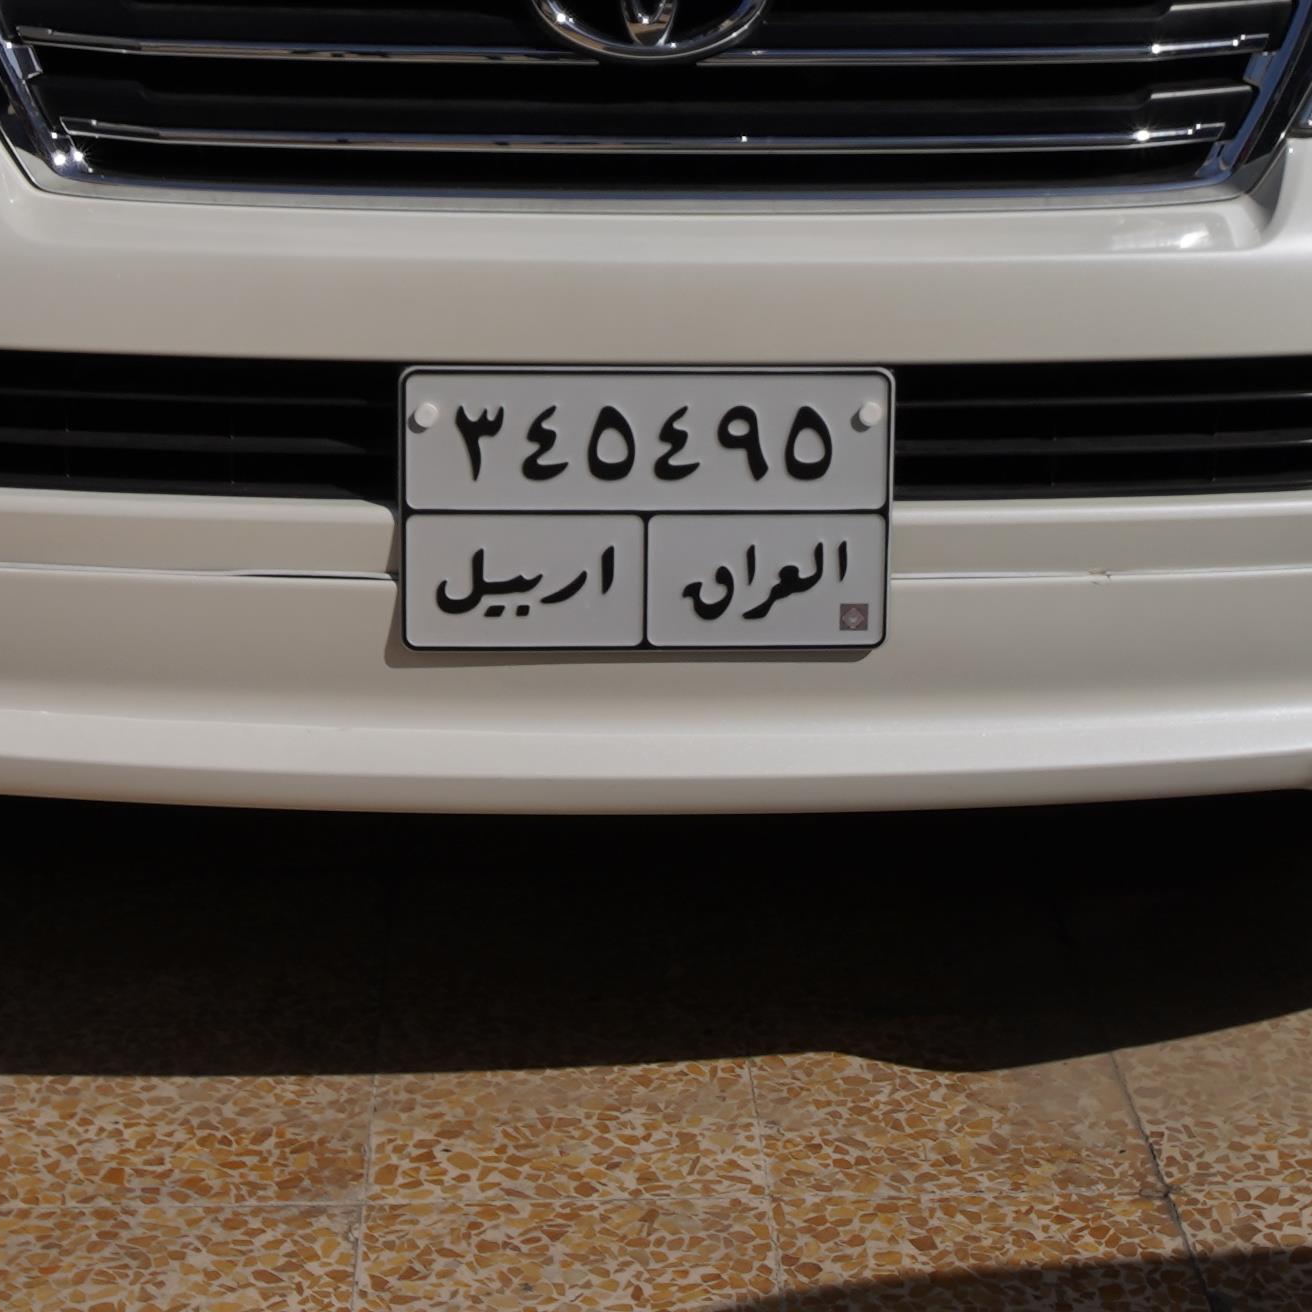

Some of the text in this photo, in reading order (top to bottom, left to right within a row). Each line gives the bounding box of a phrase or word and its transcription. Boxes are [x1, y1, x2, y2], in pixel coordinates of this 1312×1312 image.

[455, 405, 833, 482] ٣٤٥٤٩٥
[436, 545, 615, 618] اربيل
[682, 540, 849, 620] العراق
